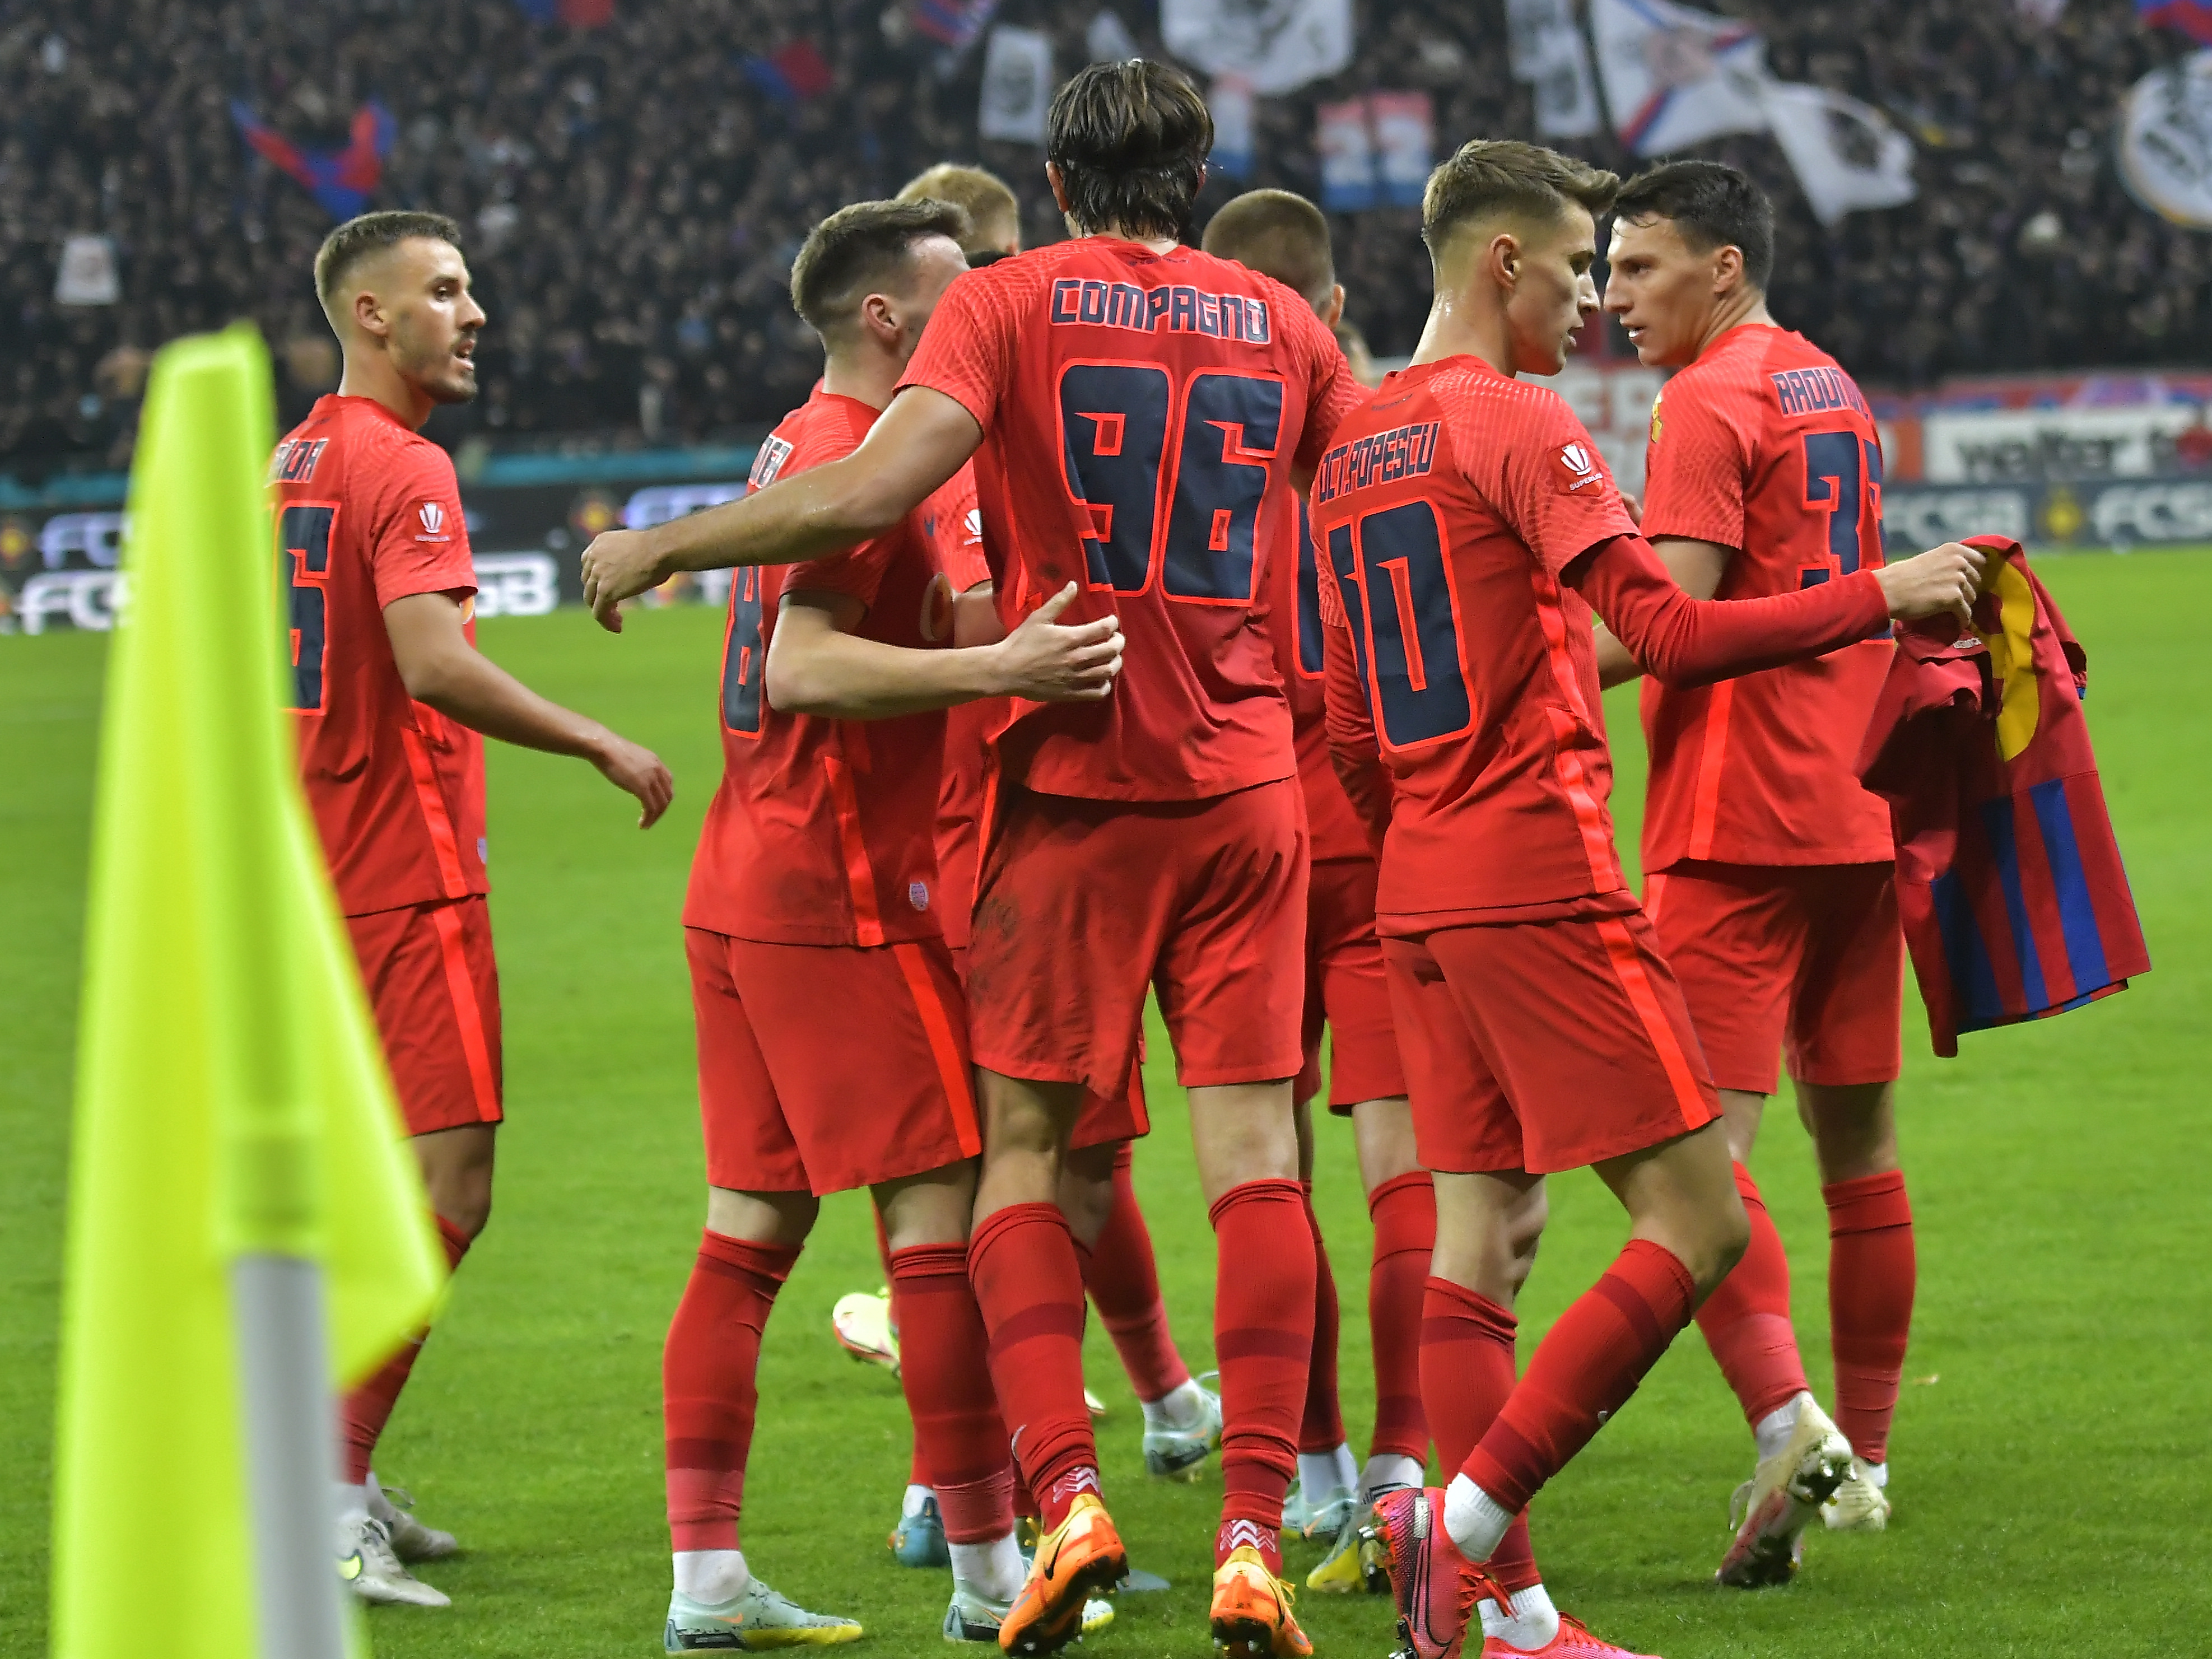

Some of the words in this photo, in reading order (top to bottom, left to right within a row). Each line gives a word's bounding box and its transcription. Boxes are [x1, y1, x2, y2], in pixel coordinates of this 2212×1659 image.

[1050, 278, 1271, 344] COMPAGNO
[1056, 358, 1288, 607] 96
[1324, 496, 1479, 753] 10
